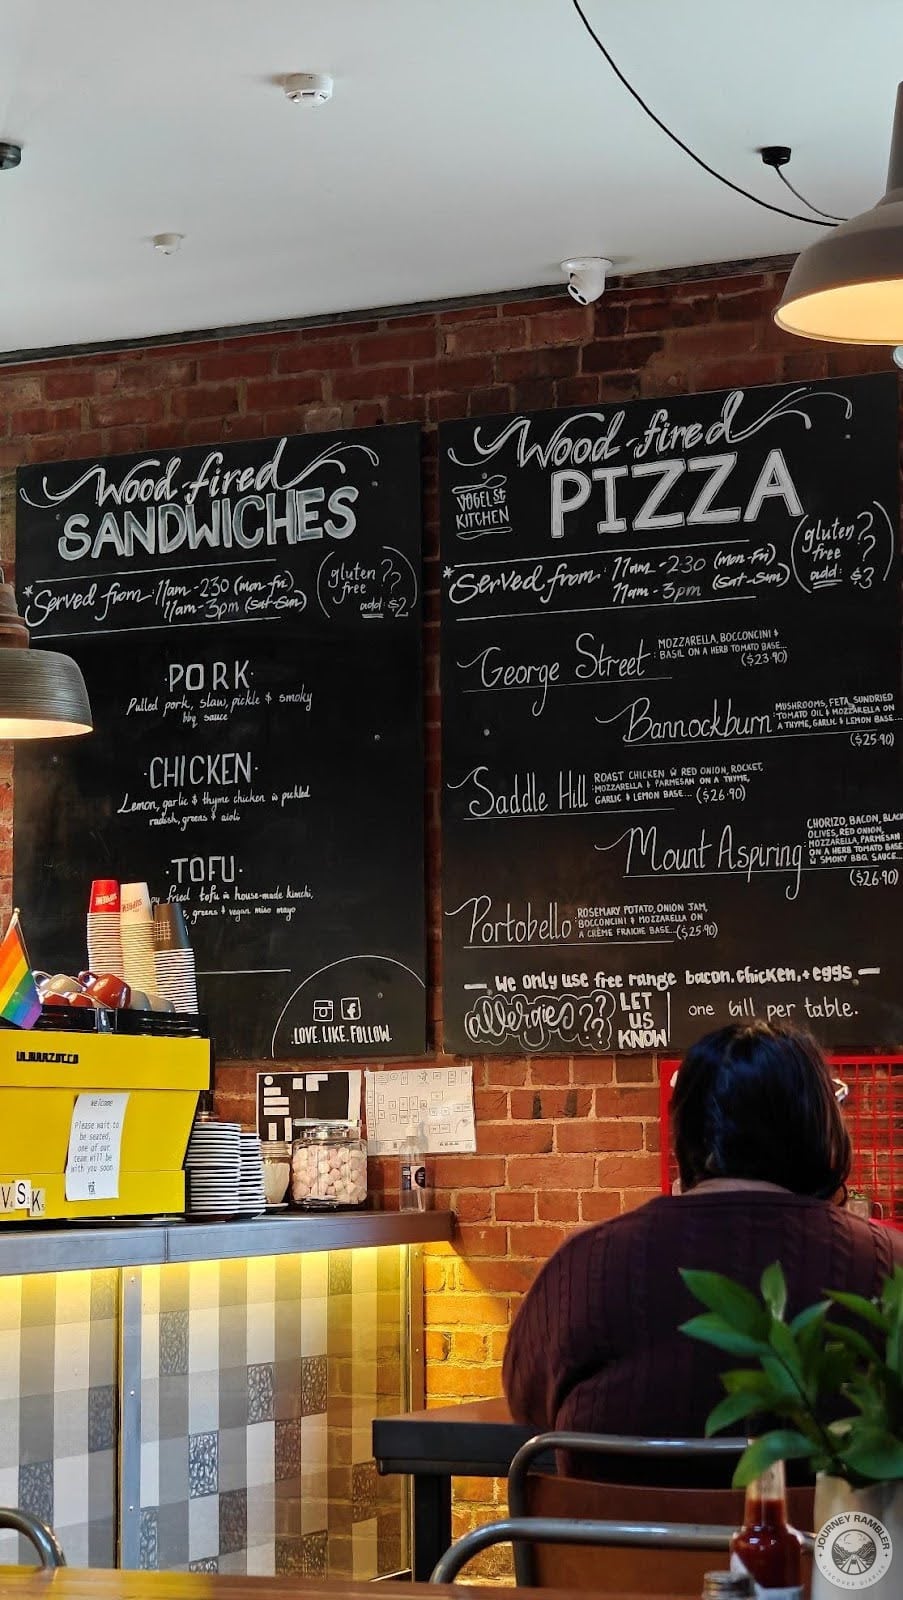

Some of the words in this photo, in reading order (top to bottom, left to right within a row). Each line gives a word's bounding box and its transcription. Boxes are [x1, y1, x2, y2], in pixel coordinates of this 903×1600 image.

[456, 491, 493, 512] VOGEL
[551, 448, 804, 539] PIZZA
[58, 486, 359, 561] SANDWICHES
[456, 505, 510, 530] KITCHEN
[802, 517, 855, 553] gluten
[812, 542, 842, 562] free
[328, 562, 376, 588] gluten
[850, 567, 875, 589] $3
[333, 581, 367, 604] free
[388, 596, 409, 618] $2
[658, 634, 719, 650] MOZZARELLA,
[720, 629, 772, 643] BOCCONCINI
[660, 650, 685, 660] BASIL
[688, 647, 700, 656] ON
[710, 645, 728, 654] HERB
[730, 643, 759, 652] TOMATO
[168, 659, 250, 692] PORK
[457, 647, 560, 716] George
[575, 633, 650, 678] Street
[126, 696, 159, 715] Pulled
[163, 694, 193, 717] pork,
[230, 690, 260, 713] pickle
[279, 684, 313, 712] smoky
[853, 693, 894, 704] SUNDRIED
[183, 712, 198, 728] bbq
[204, 713, 229, 722] sauce
[597, 697, 773, 742] Bannockburn
[776, 710, 808, 720] TOMATO
[811, 709, 824, 717] OIL
[832, 706, 881, 715] MOZZARELLA
[883, 704, 895, 712] ON
[813, 718, 837, 727] GARLIC
[846, 716, 871, 725] LEMON
[149, 752, 252, 789] CHICKEN
[594, 770, 624, 783] ROAST
[628, 769, 665, 780] CHICKEN
[681, 767, 698, 777] RED
[449, 766, 548, 817] Saddle
[559, 769, 589, 810] Hill
[594, 782, 643, 793] MOZZARELLA
[655, 778, 695, 788] PARMESAN
[162, 791, 189, 817] garlic
[202, 791, 230, 812] thyme
[233, 787, 266, 804] chicken
[594, 794, 622, 805] GARLIC
[633, 790, 660, 801] LEMON
[181, 815, 208, 832] greens
[807, 816, 848, 830] CHORIZO,
[849, 814, 882, 825] BACON,
[839, 827, 855, 836] RED
[808, 849, 821, 857] ON
[832, 846, 852, 854] HERB
[854, 844, 883, 853] TOMATO
[820, 855, 847, 864] SMOKY
[850, 854, 868, 862] BBQ
[171, 855, 235, 883] TOFU
[597, 826, 712, 873] Mount
[717, 825, 803, 900] Aspiring
[167, 885, 191, 905] fried
[199, 885, 220, 903] tofu
[191, 908, 218, 924] greens
[229, 908, 250, 923] vegan
[255, 905, 272, 914] miso
[276, 905, 296, 922] mayo
[447, 895, 572, 943] Portobello
[577, 906, 621, 919] ROSEMARY
[657, 903, 685, 913] ONION
[577, 916, 627, 928] BOCCONCINI
[638, 914, 687, 924] MOZZARELLA
[690, 912, 704, 921] ON
[523, 971, 557, 990] only
[562, 972, 589, 988] use
[594, 971, 623, 988] free
[629, 971, 677, 991] range
[812, 964, 852, 982] eggs
[619, 992, 652, 1011] LET
[688, 1005, 715, 1016] one
[728, 997, 755, 1017] bill
[766, 1003, 796, 1022] per
[617, 1028, 668, 1049] KNOW
